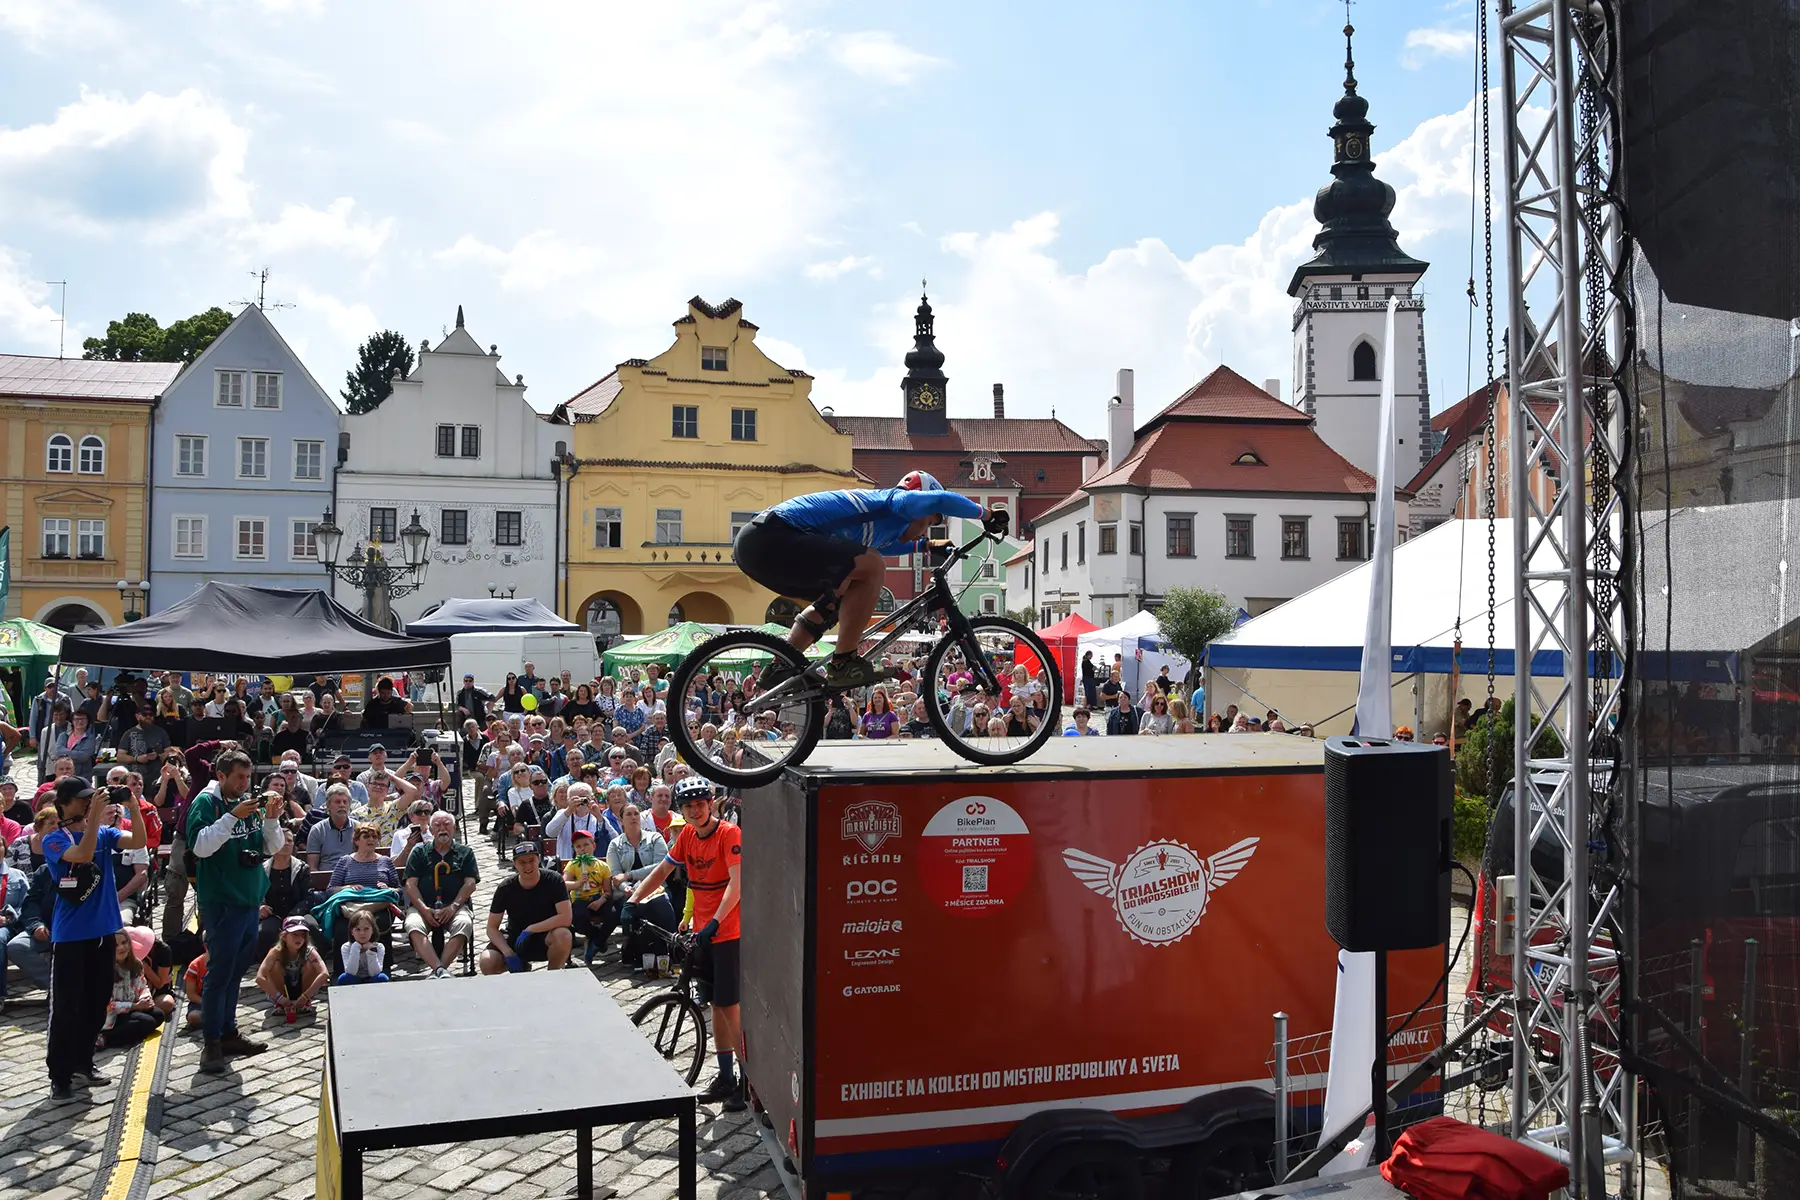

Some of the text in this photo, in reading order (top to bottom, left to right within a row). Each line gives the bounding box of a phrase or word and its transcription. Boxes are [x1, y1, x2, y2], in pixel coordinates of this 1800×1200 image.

[957, 817, 996, 826] BikePlan
[952, 837, 1000, 847] PARTNER
[80, 874, 101, 902] adidas
[1120, 870, 1200, 901] TRIALSHOW
[975, 898, 1004, 906] ZDARMA
[1137, 885, 1189, 906] IMPOSSIBLE
[841, 918, 891, 935] maloja
[1127, 908, 1196, 936] FUN ON OBSTACLES
[844, 948, 900, 960] LEZYNE
[854, 984, 901, 995] GATORADE
[841, 1053, 1180, 1102] EXHIBICE NA KOLECH OD MISTRU REPUBLIKY A SVETA
